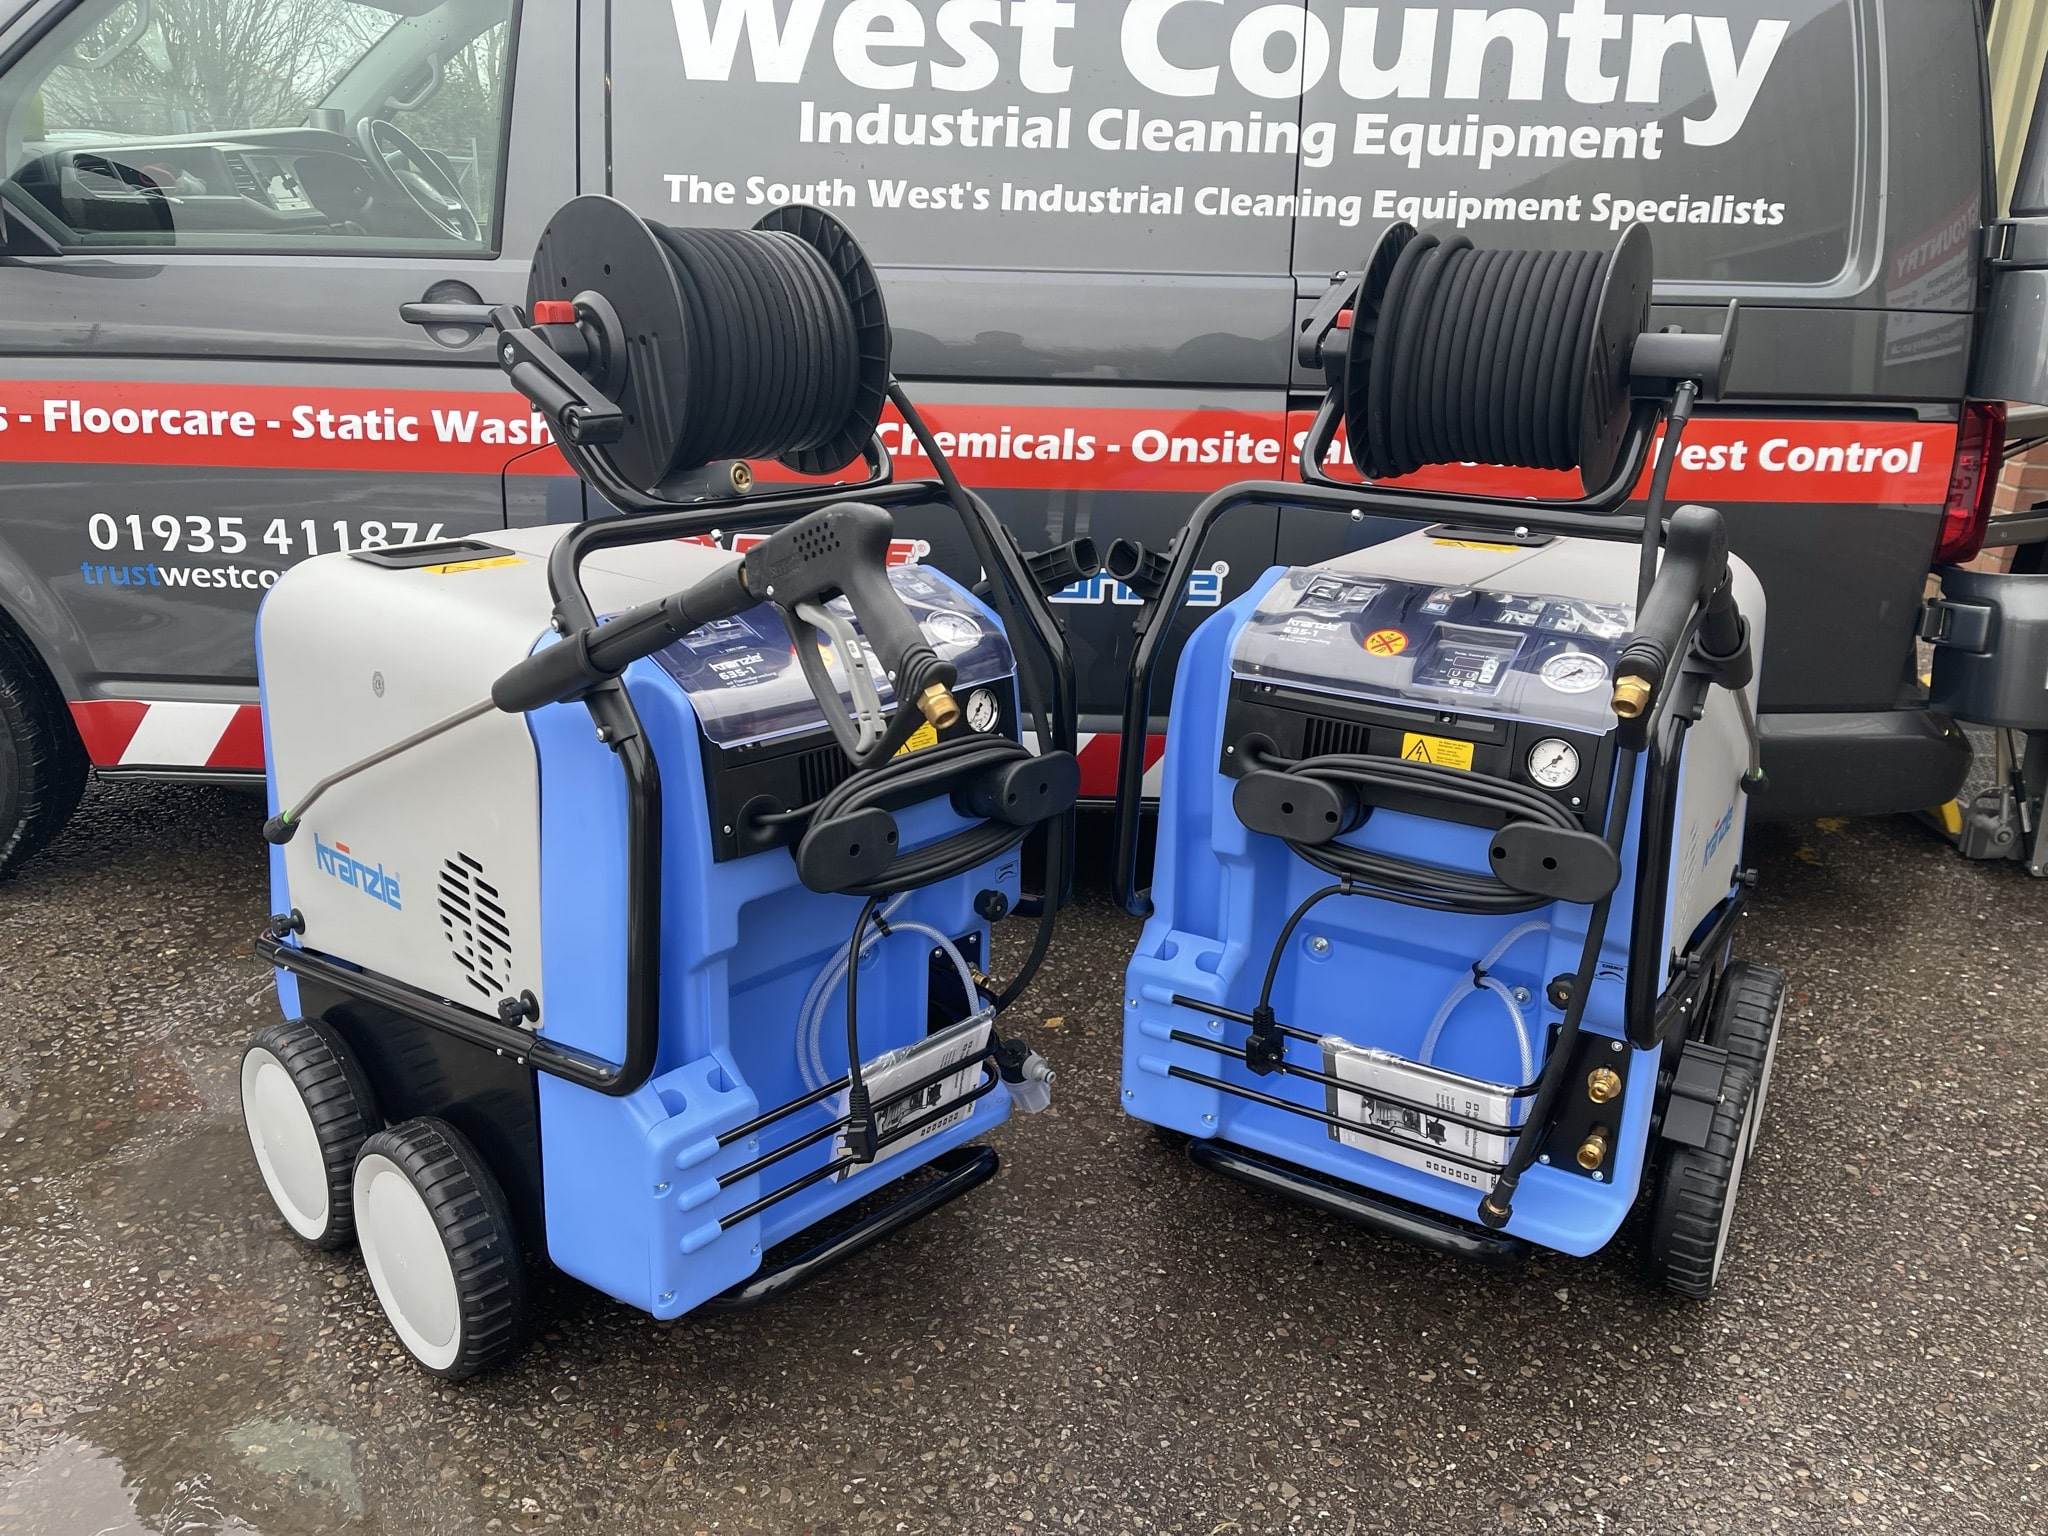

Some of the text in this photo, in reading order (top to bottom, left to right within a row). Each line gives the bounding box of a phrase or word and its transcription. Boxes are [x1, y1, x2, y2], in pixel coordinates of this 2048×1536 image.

[670, 0, 1791, 147] West Country
[799, 101, 1664, 170] Industrial Cleaning Equipment
[663, 173, 1785, 231] The South West's Industrial Cleaning Equipment Specialists
[43, 399, 256, 437] Floorcare
[292, 405, 418, 442] Static
[431, 410, 556, 446] Wash
[876, 421, 1096, 461] Chemicals
[1131, 429, 1280, 464] Onsite
[1759, 438, 1923, 473] Control
[88, 513, 247, 554] 01935
[80, 561, 287, 590] trustwestco
[313, 831, 403, 911] kränzle
